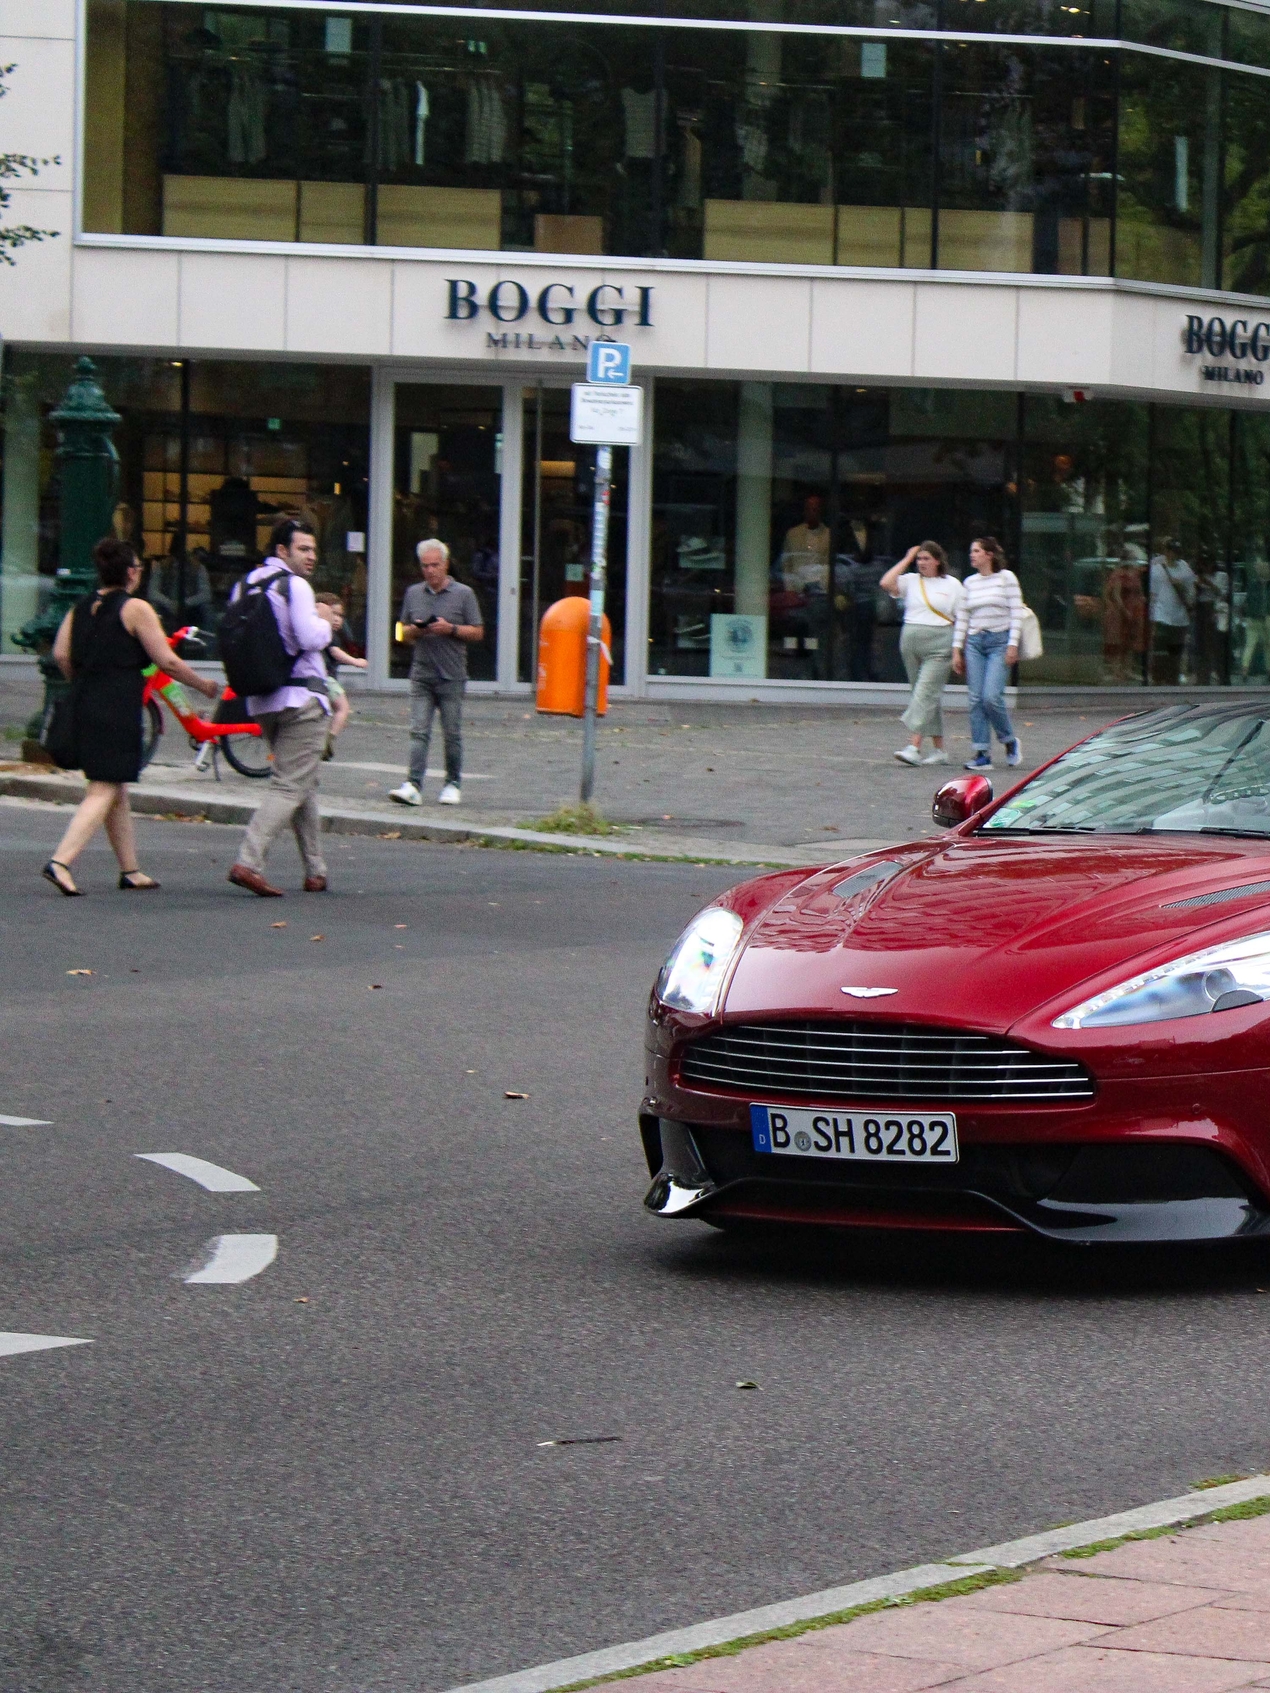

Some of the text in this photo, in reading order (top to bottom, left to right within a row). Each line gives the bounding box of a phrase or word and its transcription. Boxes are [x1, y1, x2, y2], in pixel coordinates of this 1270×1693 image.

[443, 278, 656, 327] BOGGI
[597, 347, 622, 378] P
[1202, 365, 1265, 385] MILANO
[758, 1133, 766, 1145] D
[770, 1112, 951, 1156] B SH 8282
